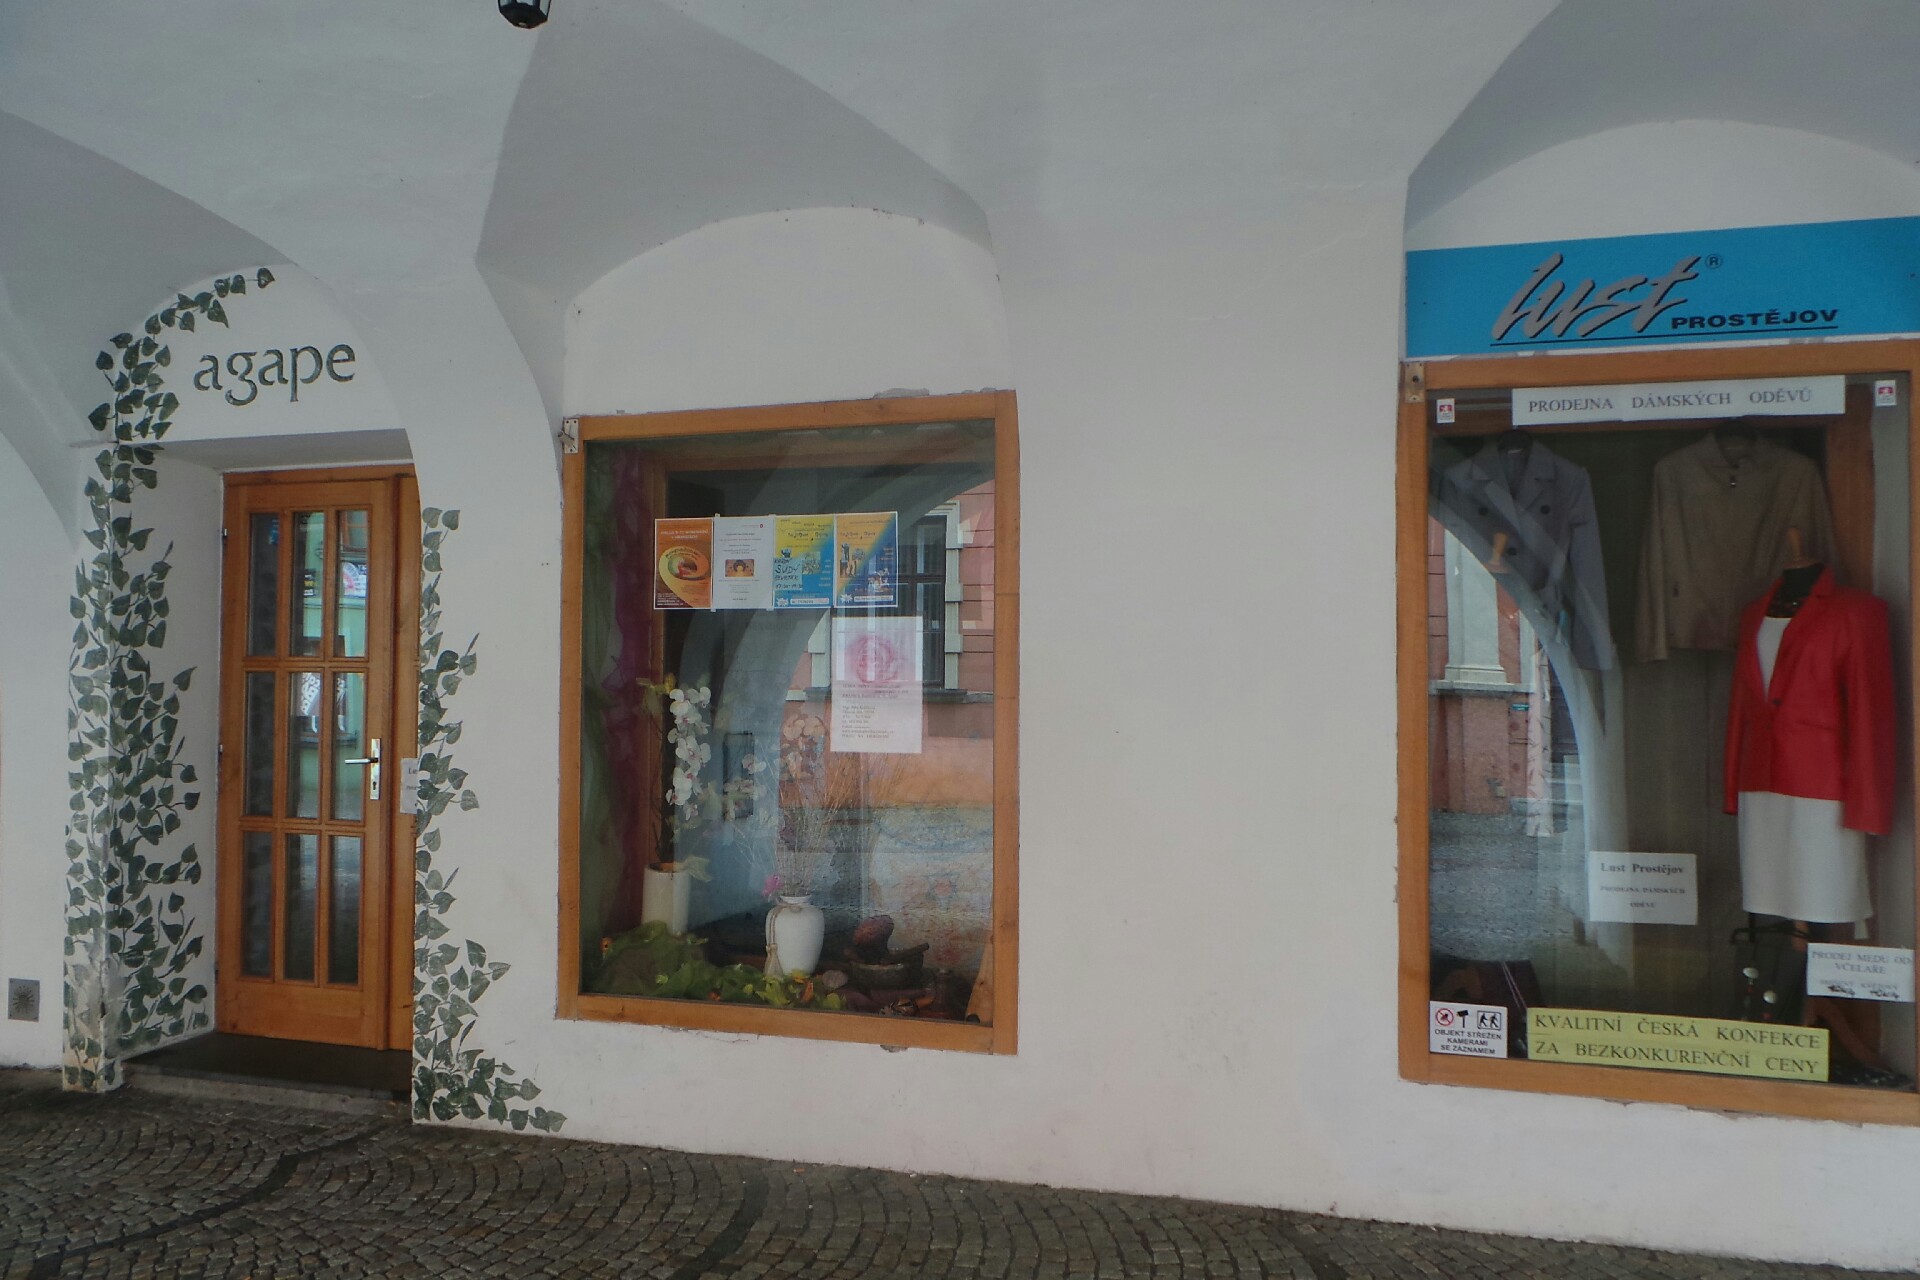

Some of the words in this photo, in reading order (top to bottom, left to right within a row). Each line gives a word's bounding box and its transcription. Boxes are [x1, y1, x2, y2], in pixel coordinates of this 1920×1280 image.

[1671, 308, 1838, 329] PROSTĚJOV
[193, 343, 356, 406] agape
[1529, 397, 1614, 413] PRODEJNA
[1631, 390, 1731, 409] DÁMSKÝCH
[1749, 387, 1812, 404] ODĚVŮ
[1600, 862, 1625, 872] Lust
[1632, 863, 1684, 876] Prostějov
[1812, 951, 1851, 961] PRODEJ
[1857, 953, 1888, 963] MEDU
[1835, 962, 1887, 974] VČELAŘE
[1434, 1029, 1464, 1037] OBJEKT
[1467, 1031, 1502, 1040] STŘEŽEN
[1535, 1014, 1622, 1033] KVALITNÍ
[1637, 1018, 1699, 1038] ČESKÁ
[1716, 1026, 1820, 1049] KONFEKCE
[1447, 1037, 1488, 1046] KAMERAMI
[1453, 1045, 1496, 1054] ZÁZNAMEM
[1535, 1040, 1560, 1055] ZA
[1575, 1042, 1750, 1069] BEZKONKURENČNÍ
[1765, 1057, 1819, 1074] CENY
